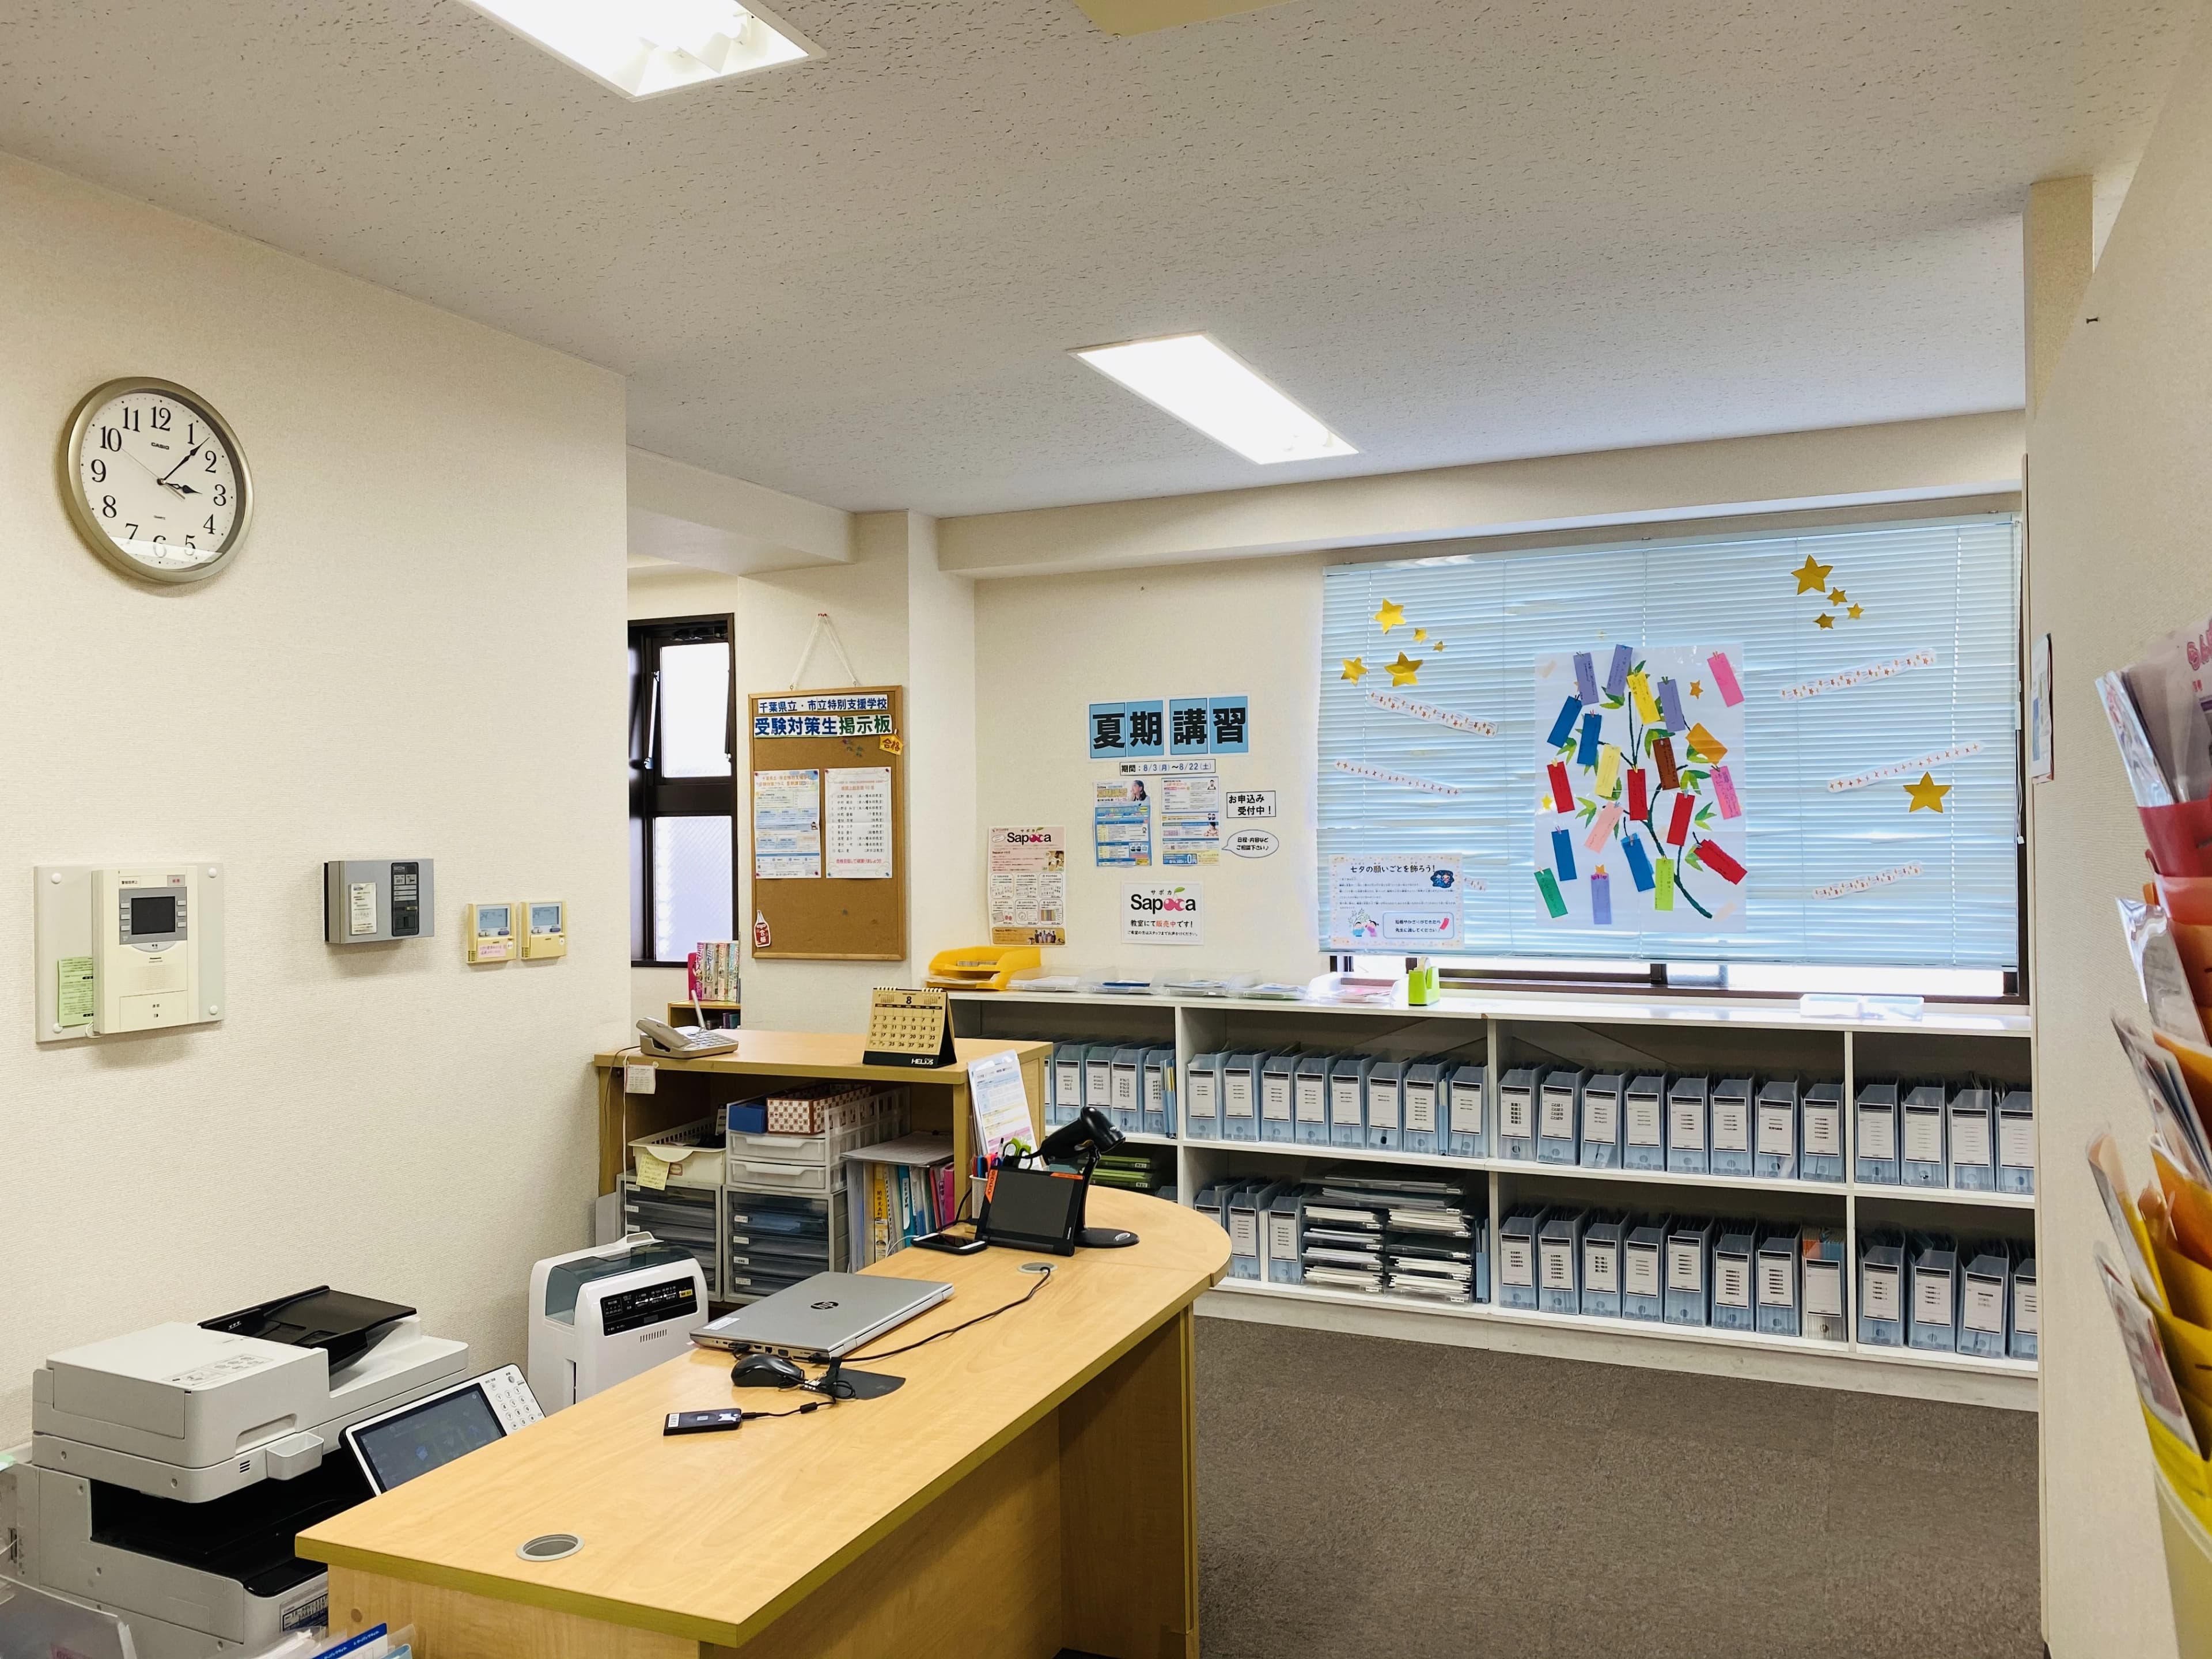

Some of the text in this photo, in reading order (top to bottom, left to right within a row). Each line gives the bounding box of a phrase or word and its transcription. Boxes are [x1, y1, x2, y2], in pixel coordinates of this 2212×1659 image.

[123, 407, 140, 432] 11
[150, 406, 171, 431] 12
[100, 426, 122, 452] 10
[187, 423, 195, 445] 1
[151, 442, 169, 450] CASIO
[91, 459, 106, 482] 9
[205, 450, 217, 473] 2
[213, 484, 226, 506] 3
[102, 495, 117, 518] 8
[124, 523, 138, 544] 7
[203, 514, 215, 534] 4
[153, 535, 166, 558] 6
[184, 535, 195, 555] 5
[759, 697, 887, 713] 千葉県立・市立特別支援学校
[755, 715, 891, 736] 受験対策生掲示板
[1093, 707, 1246, 750] 夏期講習
[882, 738, 900, 751] 合格
[1229, 794, 1264, 804] お申込み
[1238, 806, 1271, 815] 受付中！
[1007, 832, 1051, 845] Sapoca
[1131, 894, 1196, 914] Sapoca
[906, 996, 912, 1004] 8
[812, 1301, 834, 1309] hp
